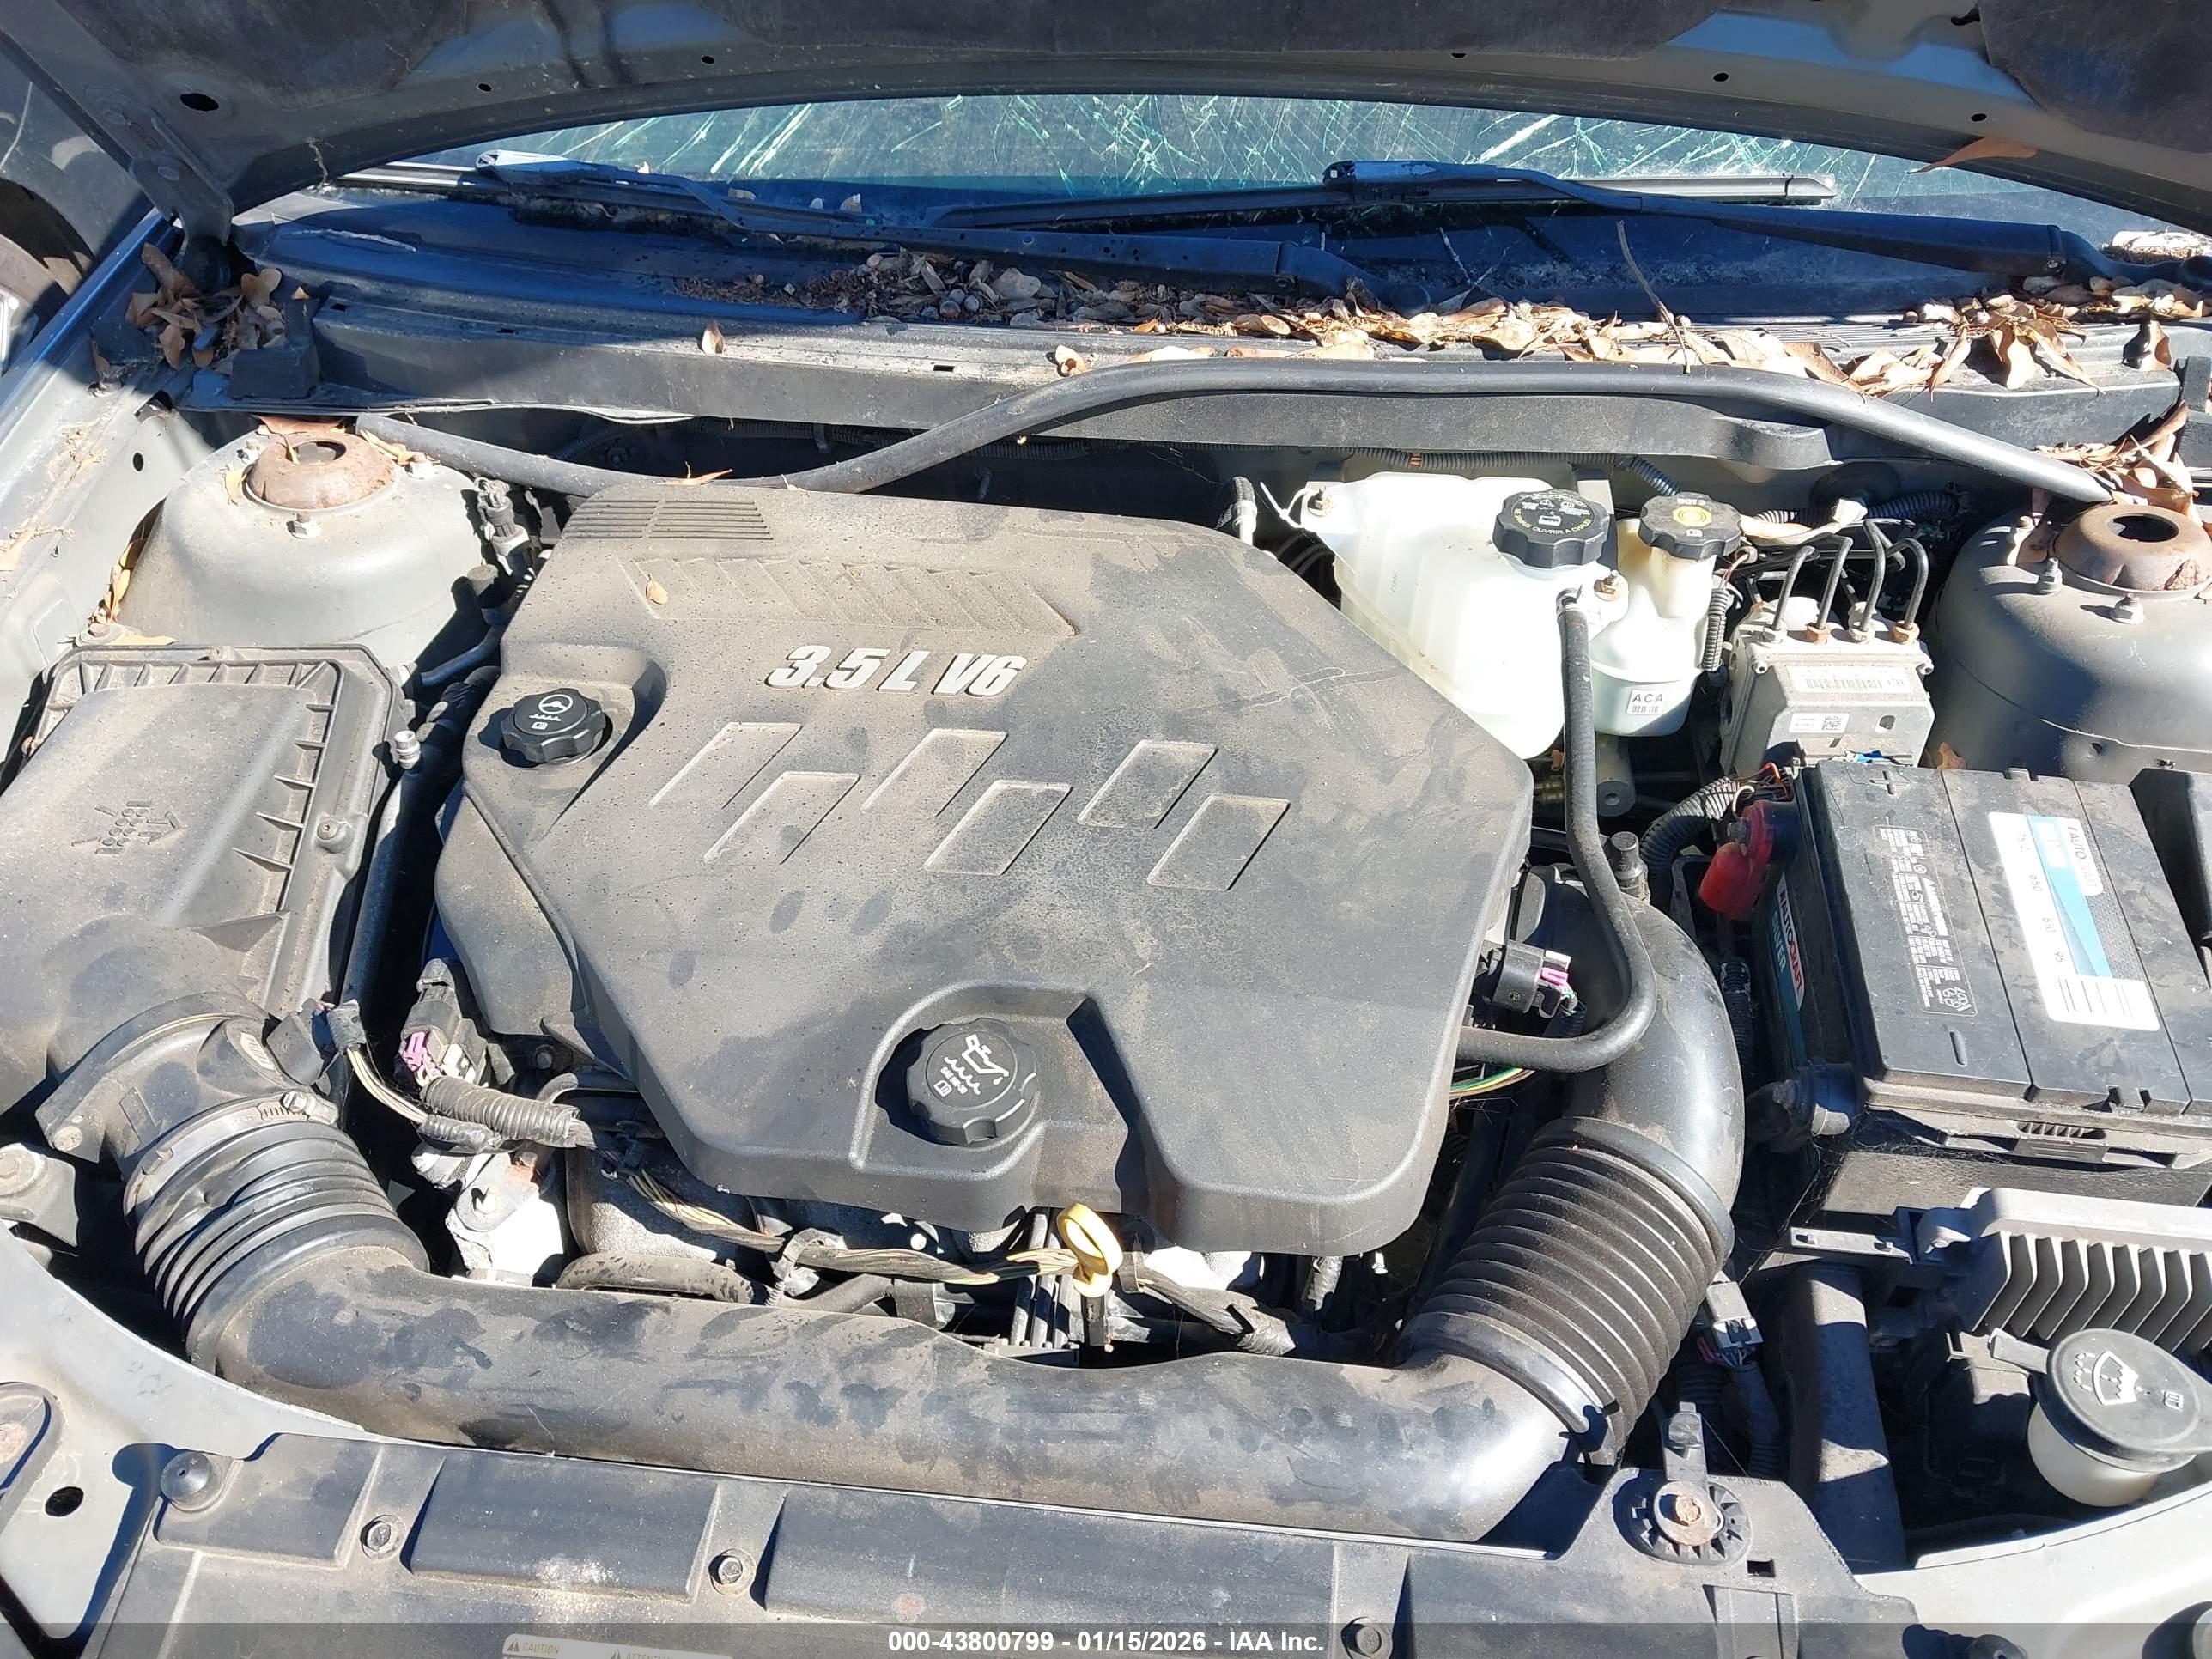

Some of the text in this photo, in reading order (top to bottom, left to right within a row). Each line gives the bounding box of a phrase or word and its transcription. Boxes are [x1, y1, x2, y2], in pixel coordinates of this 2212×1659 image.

[1532, 526, 1564, 535] OUVRIR
[764, 644, 1028, 698] 3.5 L V6
[1632, 693, 1663, 703] ACA
[1771, 911, 1787, 973] SILVER
[522, 1642, 561, 1655] CAUTION
